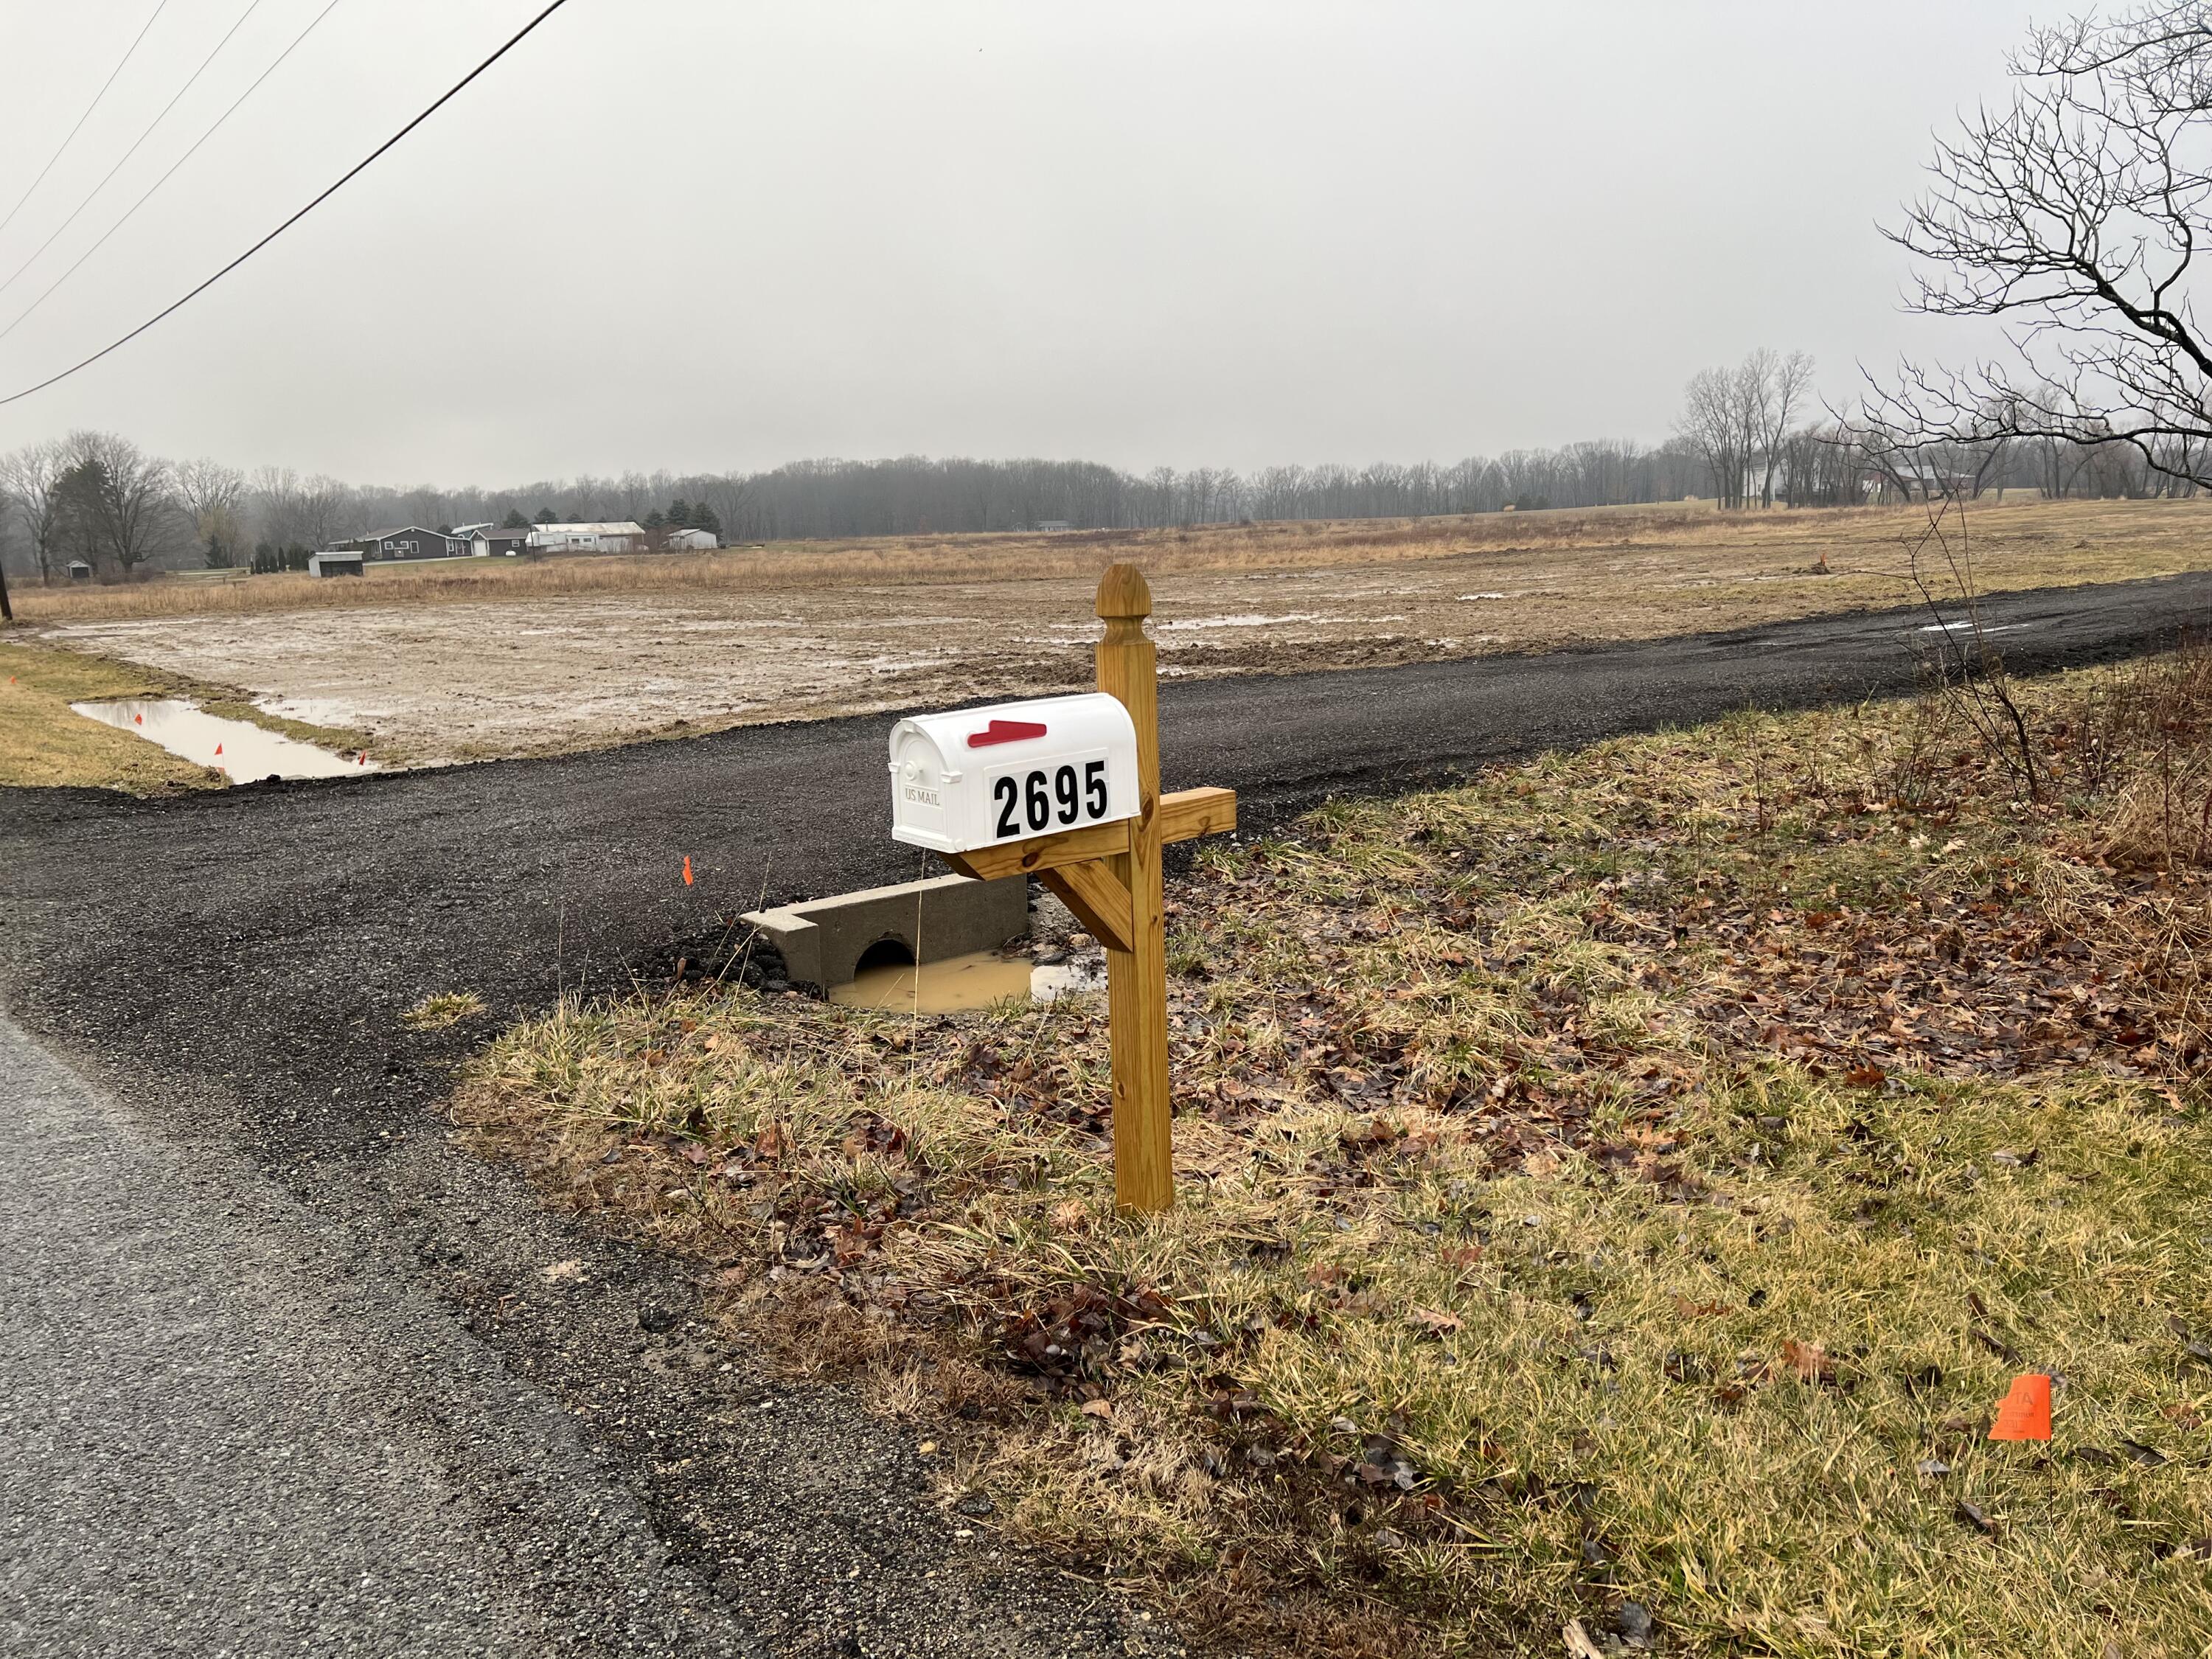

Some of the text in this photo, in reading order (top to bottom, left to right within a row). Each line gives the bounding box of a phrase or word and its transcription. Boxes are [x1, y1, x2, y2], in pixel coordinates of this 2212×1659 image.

[905, 788, 940, 806] US MAIL
[993, 760, 1107, 838] 2695
